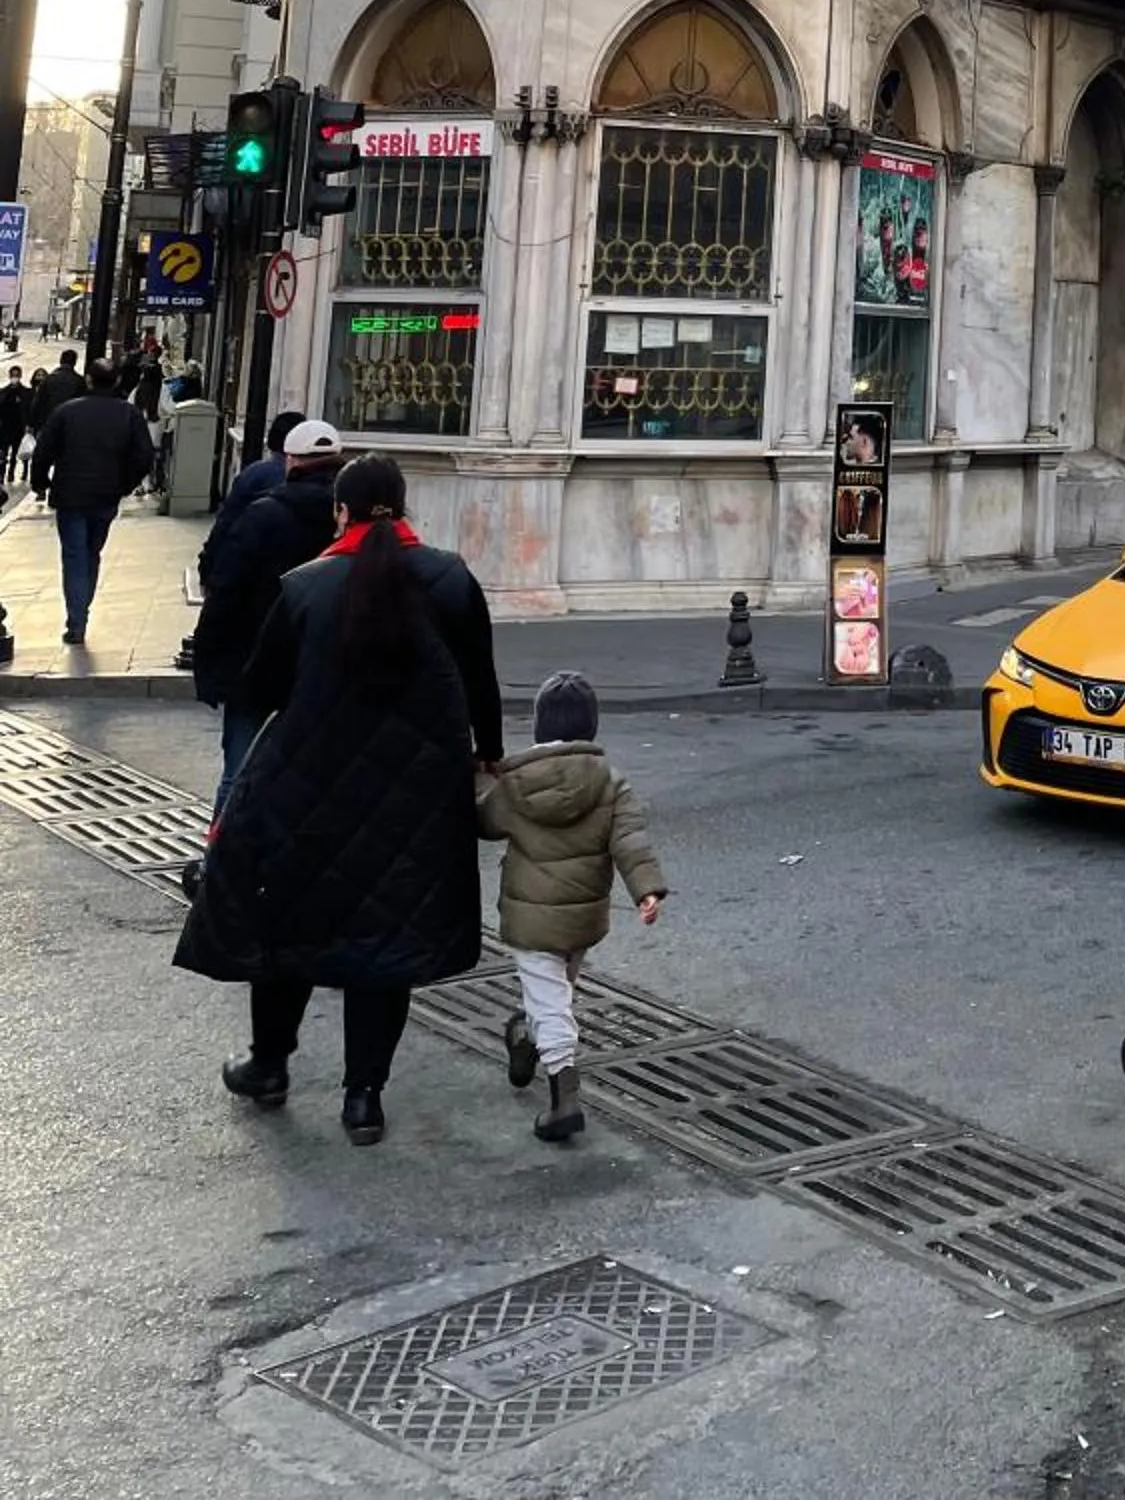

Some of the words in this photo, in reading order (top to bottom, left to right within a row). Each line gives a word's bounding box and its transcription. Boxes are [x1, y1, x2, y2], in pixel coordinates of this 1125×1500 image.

[365, 127, 420, 156] SEBİL
[427, 125, 481, 156] BÜFE
[171, 297, 205, 306] CARD
[1053, 731, 1073, 753] 34
[1083, 735, 1113, 759] TAP
